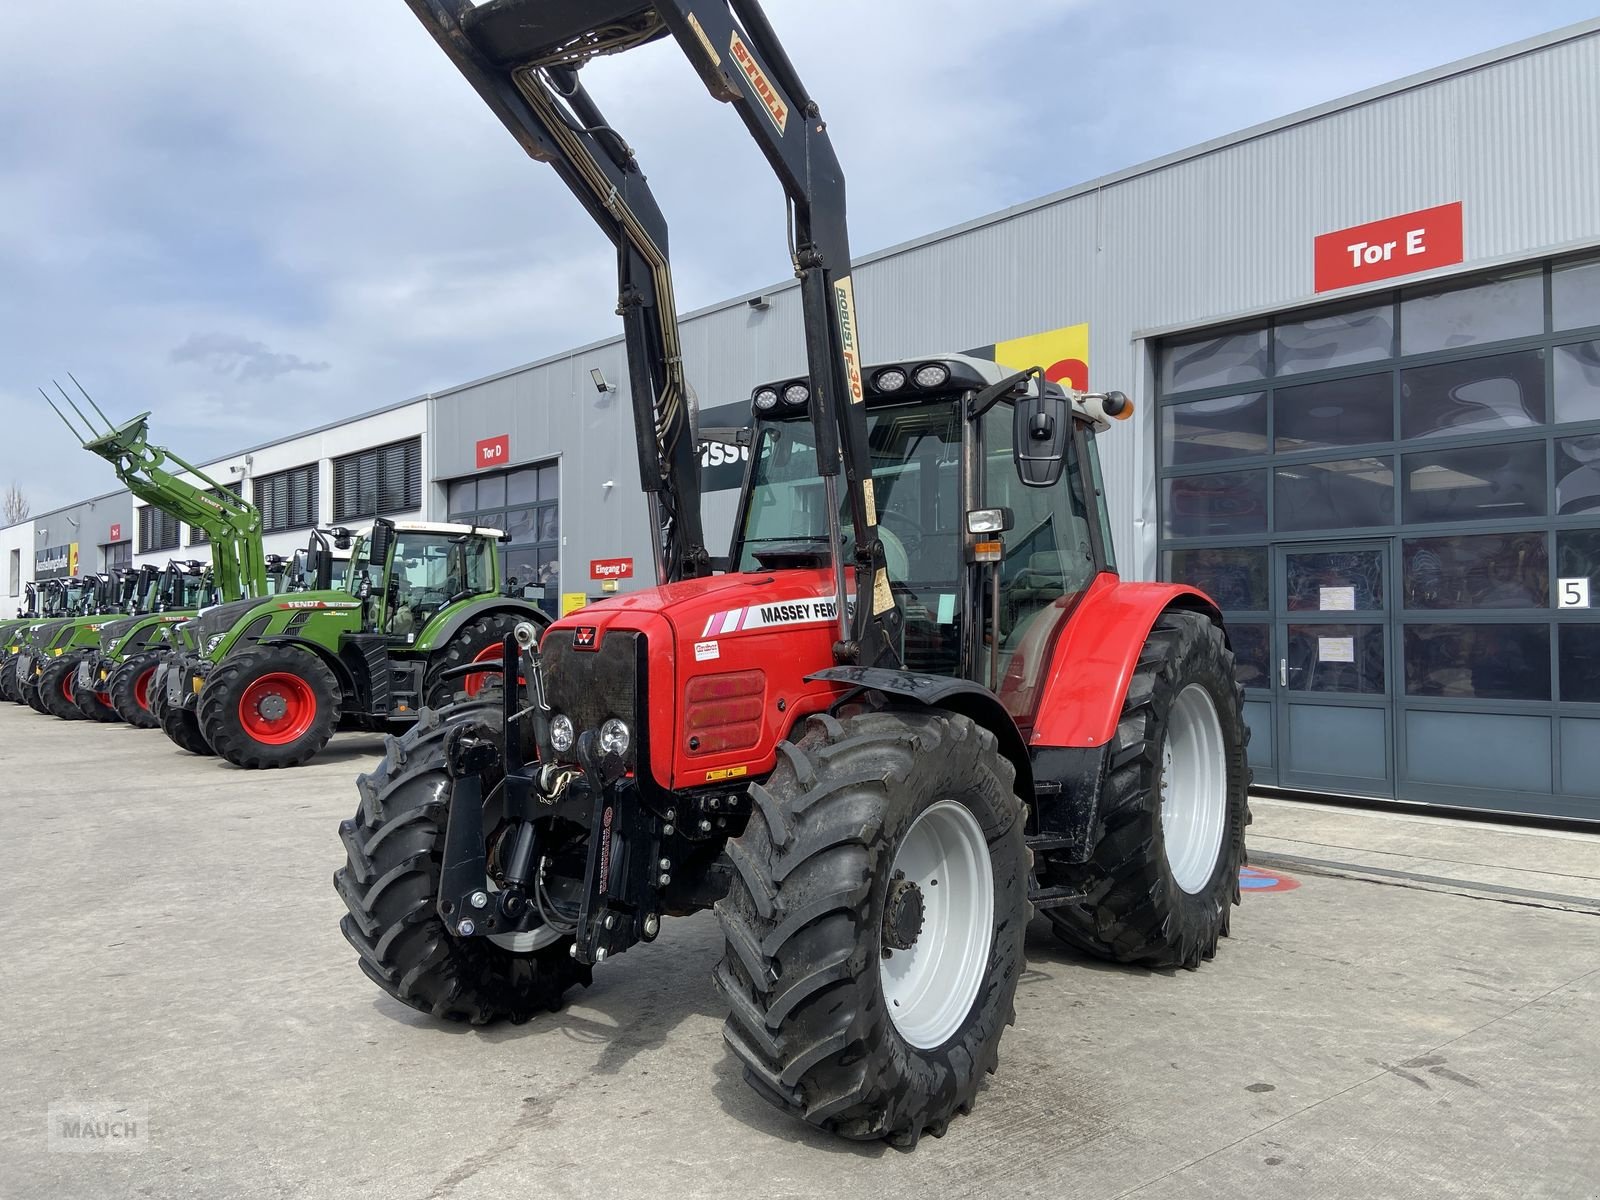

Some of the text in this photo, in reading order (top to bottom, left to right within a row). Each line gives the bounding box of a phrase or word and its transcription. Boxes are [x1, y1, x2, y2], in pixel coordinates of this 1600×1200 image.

[732, 41, 785, 125] STOLL
[1347, 228, 1426, 268] Tor E
[838, 288, 862, 399] ROBUST F 30
[483, 444, 502, 459] Tor D
[595, 563, 627, 576] Eingang D
[1565, 582, 1581, 605] 5
[288, 600, 321, 609] FENDT
[760, 604, 810, 624] MASSEY
